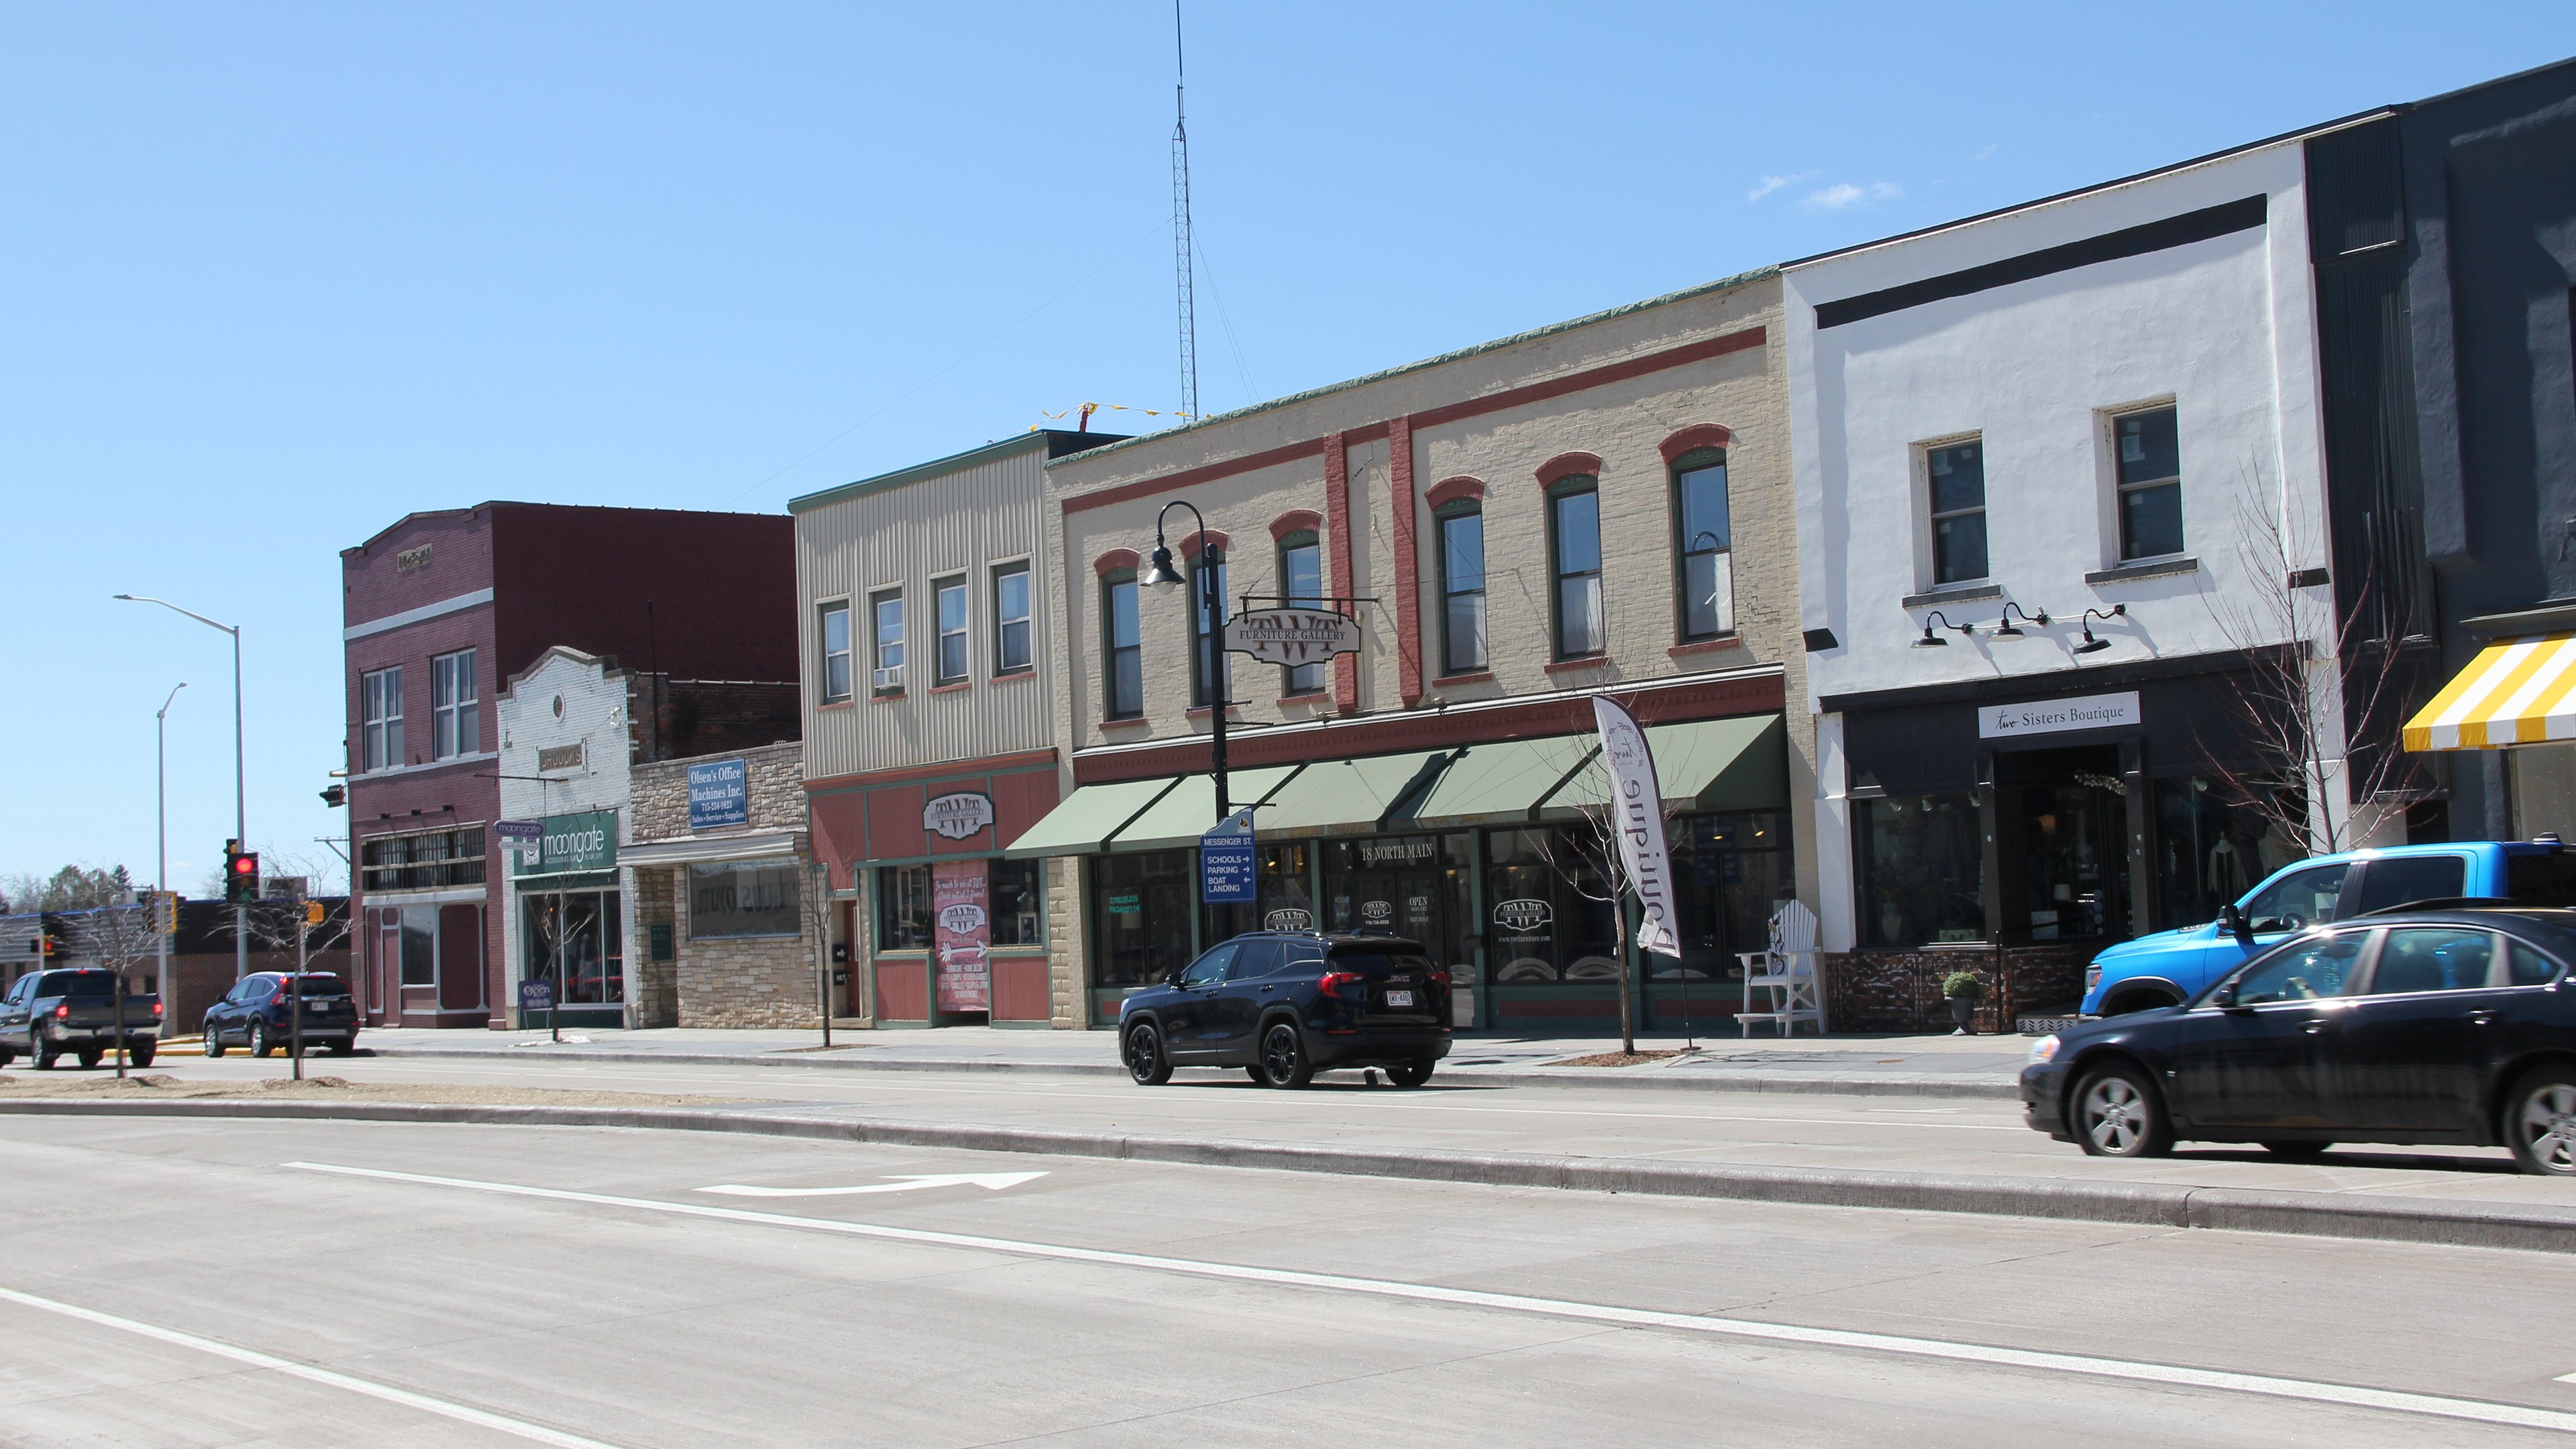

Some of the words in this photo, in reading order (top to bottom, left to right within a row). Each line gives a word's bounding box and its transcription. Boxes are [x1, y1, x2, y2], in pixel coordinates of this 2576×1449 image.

[1240, 630, 1297, 639] FURNITURE
[1301, 631, 1345, 640] GALLERY
[1248, 614, 1338, 660] TWT
[1994, 709, 2019, 730] two
[2023, 712, 2065, 726] Sisters
[2070, 706, 2124, 722] Boutique
[691, 769, 716, 784] Olsen's
[718, 766, 741, 780] Office
[691, 787, 726, 802] Machines
[728, 784, 743, 798] Inc.
[692, 814, 703, 823] Sales
[706, 812, 722, 821] Service
[724, 810, 745, 820] Supplies
[931, 810, 959, 820] FURNITURE
[961, 808, 984, 817] GALLERY
[935, 798, 980, 834] TWT
[498, 824, 541, 835] moongate
[545, 824, 604, 863] moongate
[1204, 838, 1241, 846] MESSENGER
[1362, 847, 1372, 861] 18
[1375, 845, 1404, 860] NORTH
[1407, 843, 1432, 858] MAIN
[1208, 856, 1241, 864] SCHOOLS
[1208, 866, 1238, 874] PARKING
[1208, 877, 1226, 885] BOAT
[1409, 896, 1428, 906] OPEN
[1110, 905, 1140, 913] PROMOTION
[1503, 902, 1542, 926] TWT
[947, 907, 977, 930] TWT
[524, 984, 550, 998] Open
